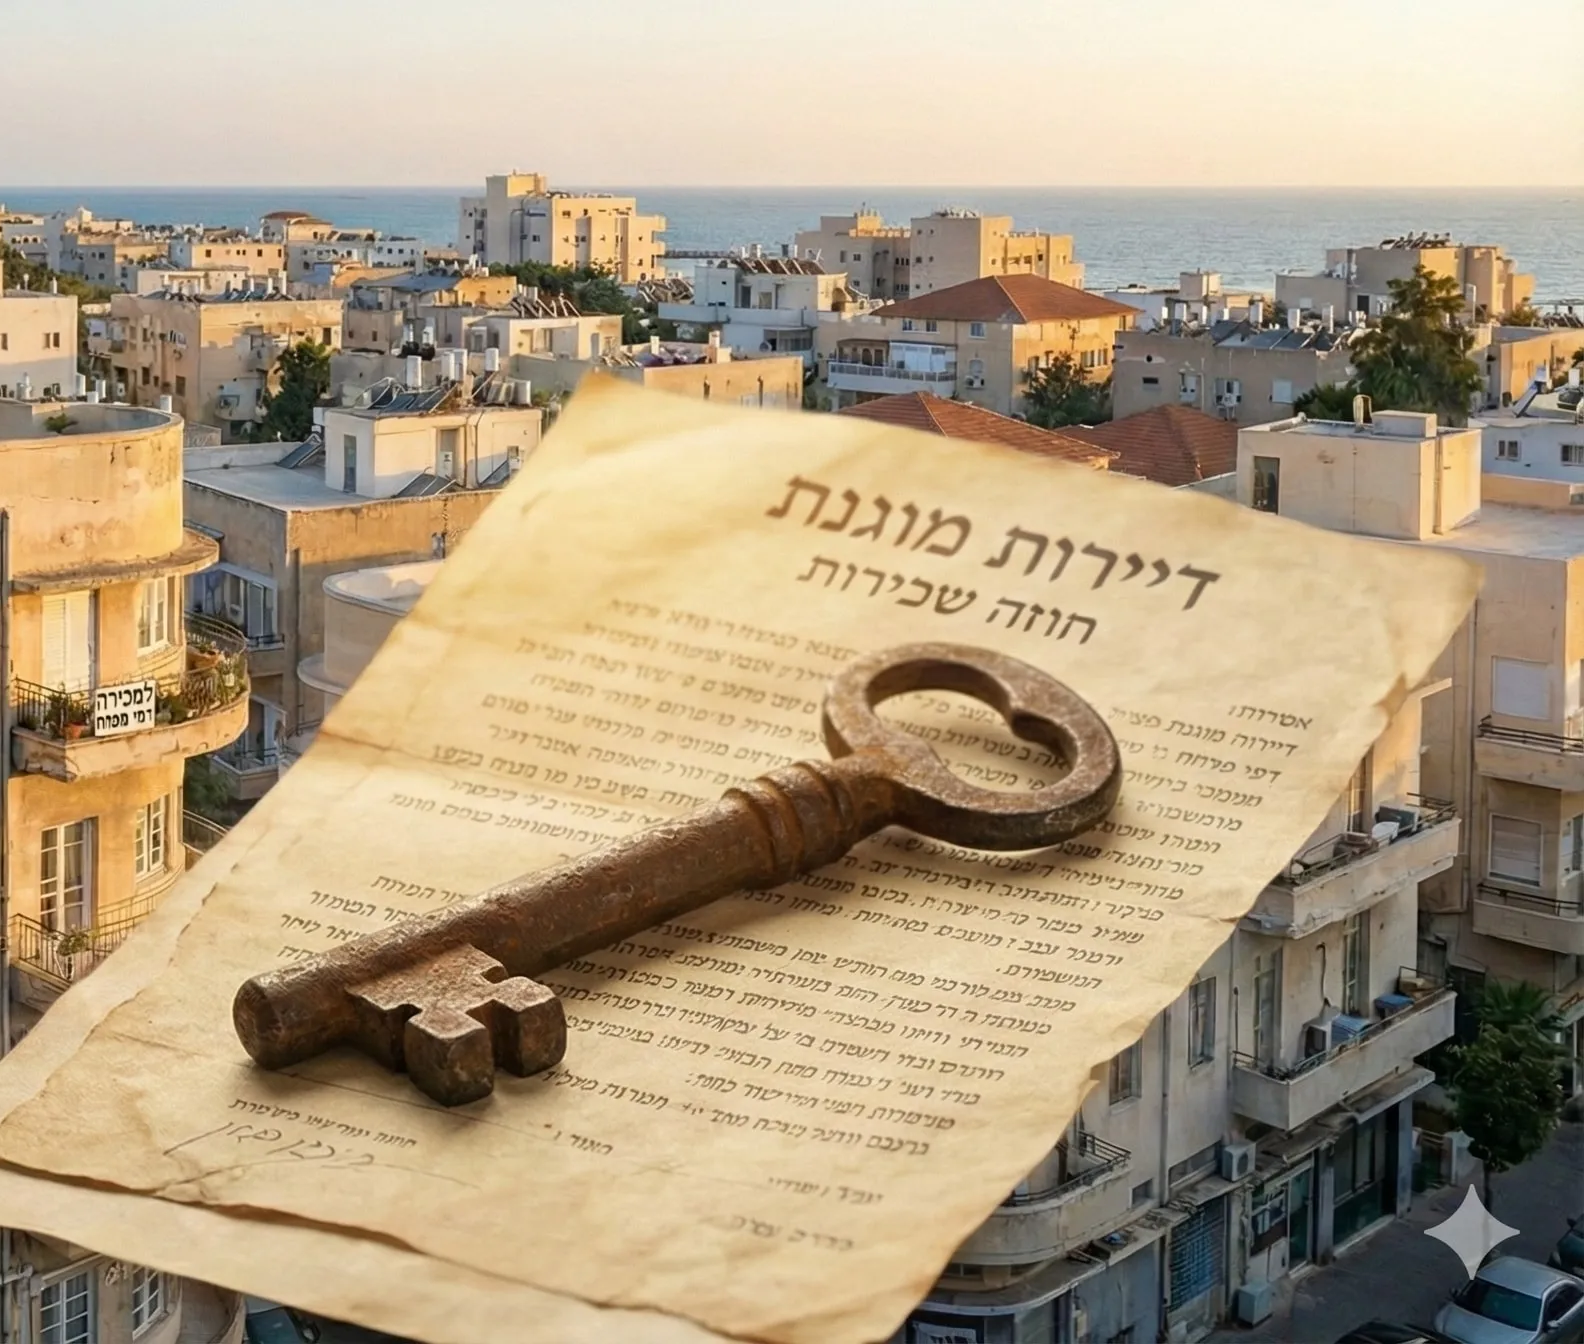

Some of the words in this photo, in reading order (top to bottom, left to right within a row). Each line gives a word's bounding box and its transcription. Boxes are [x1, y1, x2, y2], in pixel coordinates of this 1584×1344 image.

[766, 475, 972, 557] מוגנת
[797, 554, 977, 615] שכירות
[984, 525, 1221, 611] דיירות
[985, 596, 1097, 645] חוזה
[97, 681, 153, 711] למכירה
